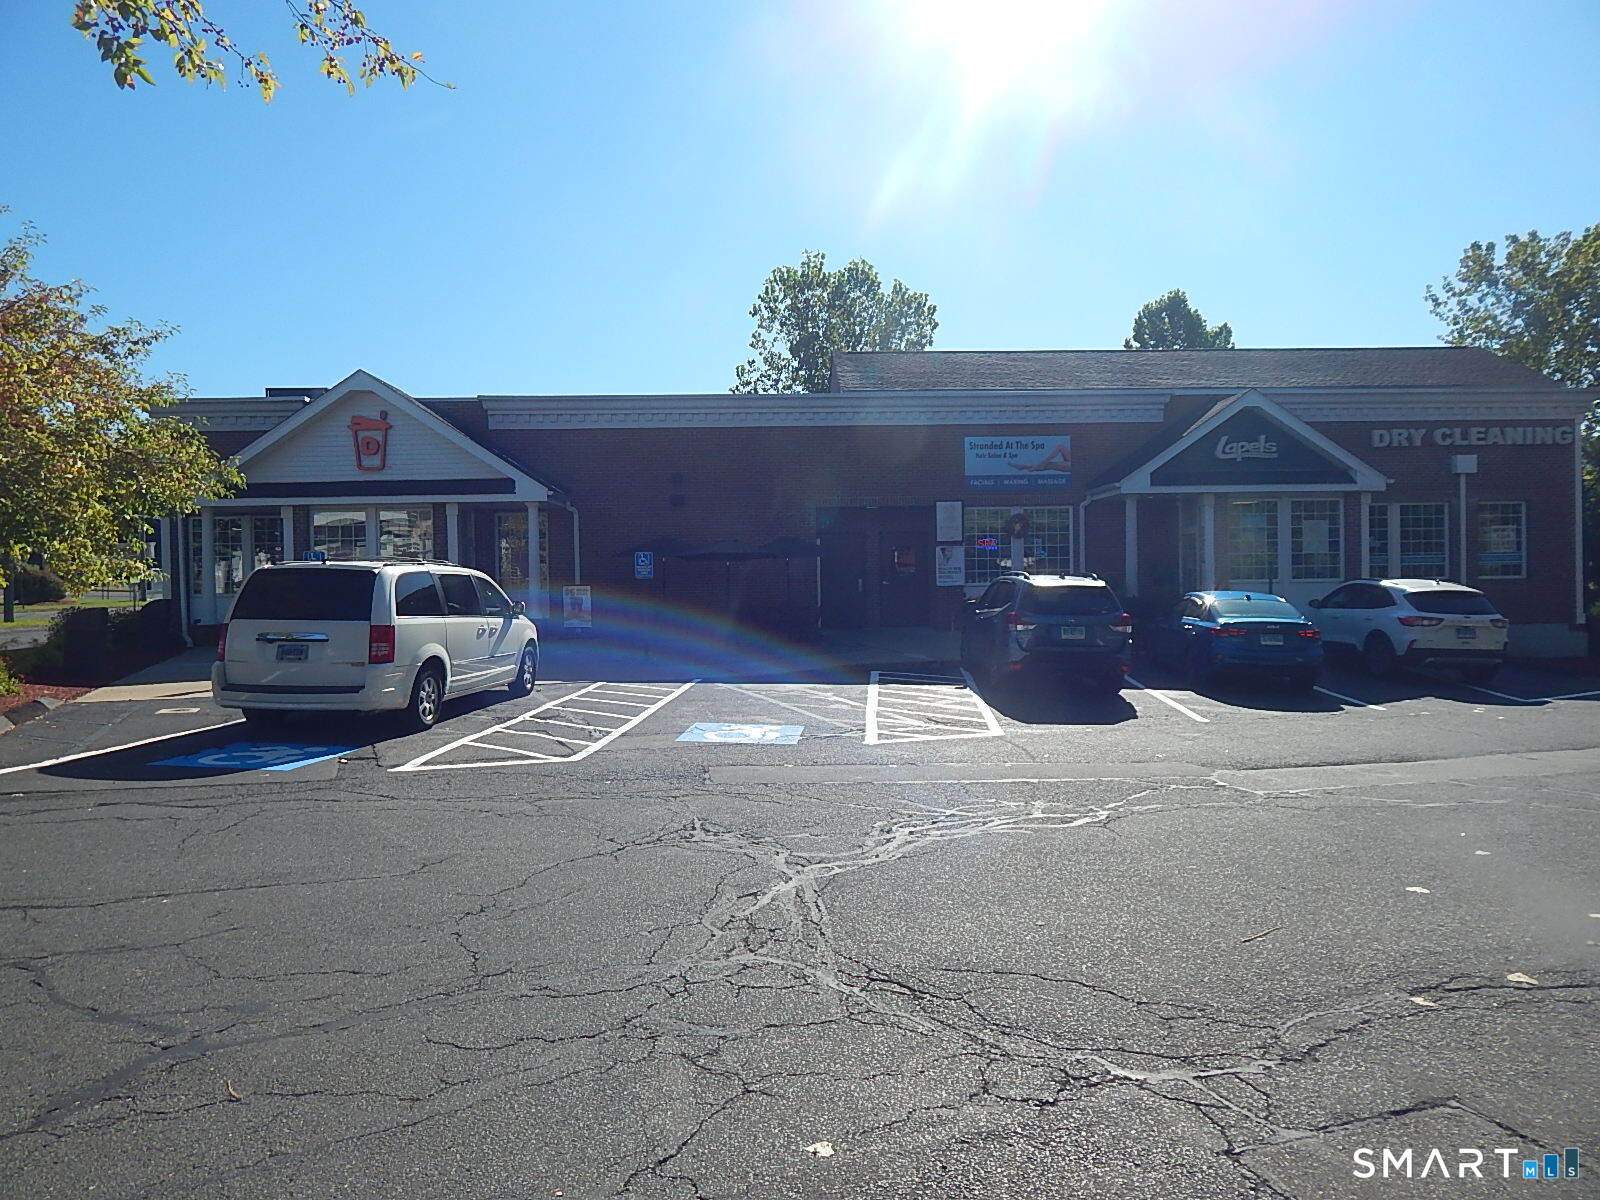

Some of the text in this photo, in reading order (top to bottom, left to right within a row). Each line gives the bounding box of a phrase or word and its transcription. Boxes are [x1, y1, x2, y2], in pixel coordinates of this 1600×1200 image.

[969, 440, 1046, 452] Stranded At The Spa
[1214, 434, 1279, 462] Lapels
[1371, 426, 1574, 448] DRY CLEANING
